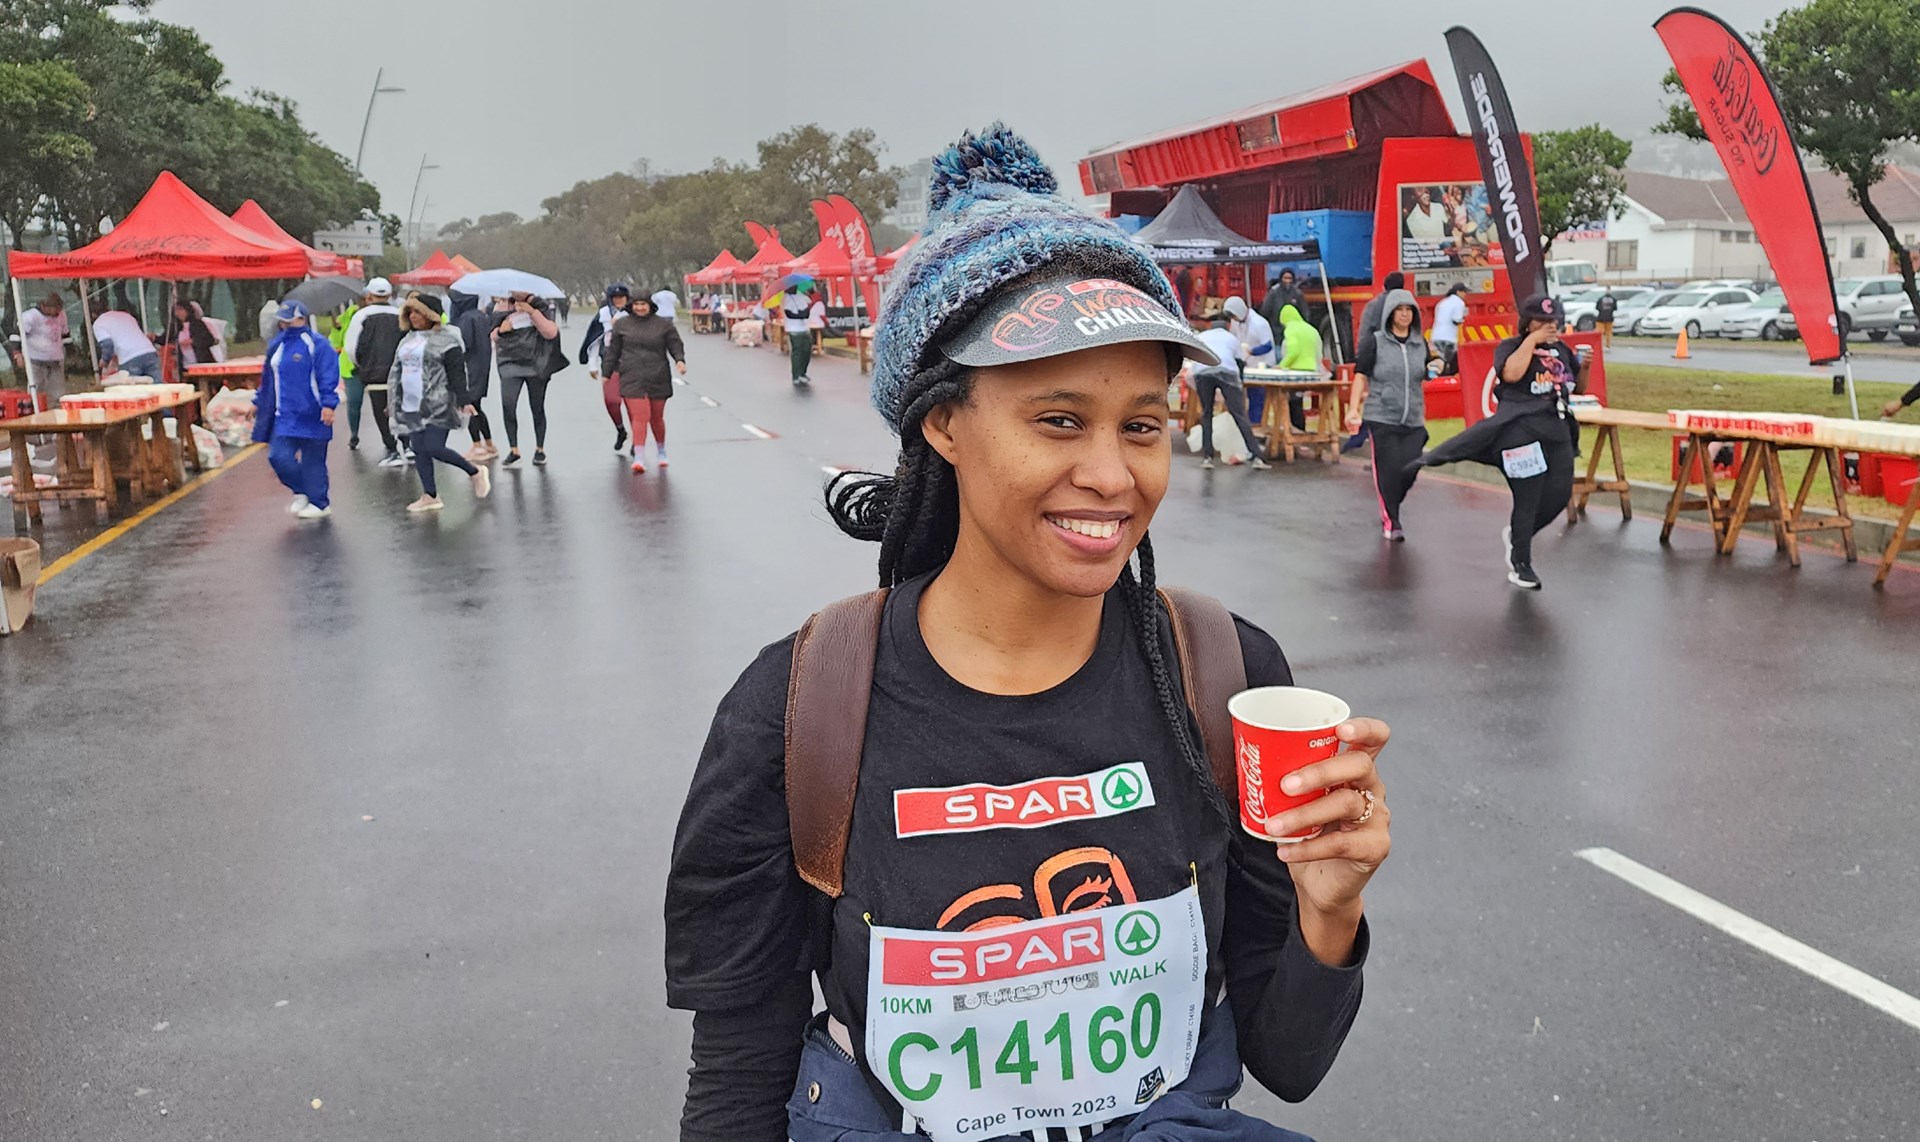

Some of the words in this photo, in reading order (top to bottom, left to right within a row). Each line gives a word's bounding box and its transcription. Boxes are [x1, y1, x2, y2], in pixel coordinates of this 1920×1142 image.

[1229, 245, 1306, 257] POWERADE
[1541, 299, 1553, 314] C
[1240, 733, 1268, 824] Coca-Cola
[945, 784, 1092, 825] SPAR
[929, 925, 1102, 980] SPAR
[880, 996, 933, 1015] 10KM
[1110, 959, 1168, 987] WALK
[888, 992, 1162, 1102] C14160
[1139, 1067, 1162, 1095] ASA
[956, 1113, 1007, 1135] Cape
[1012, 1105, 1065, 1121] Town
[1071, 1095, 1118, 1117] 2023
